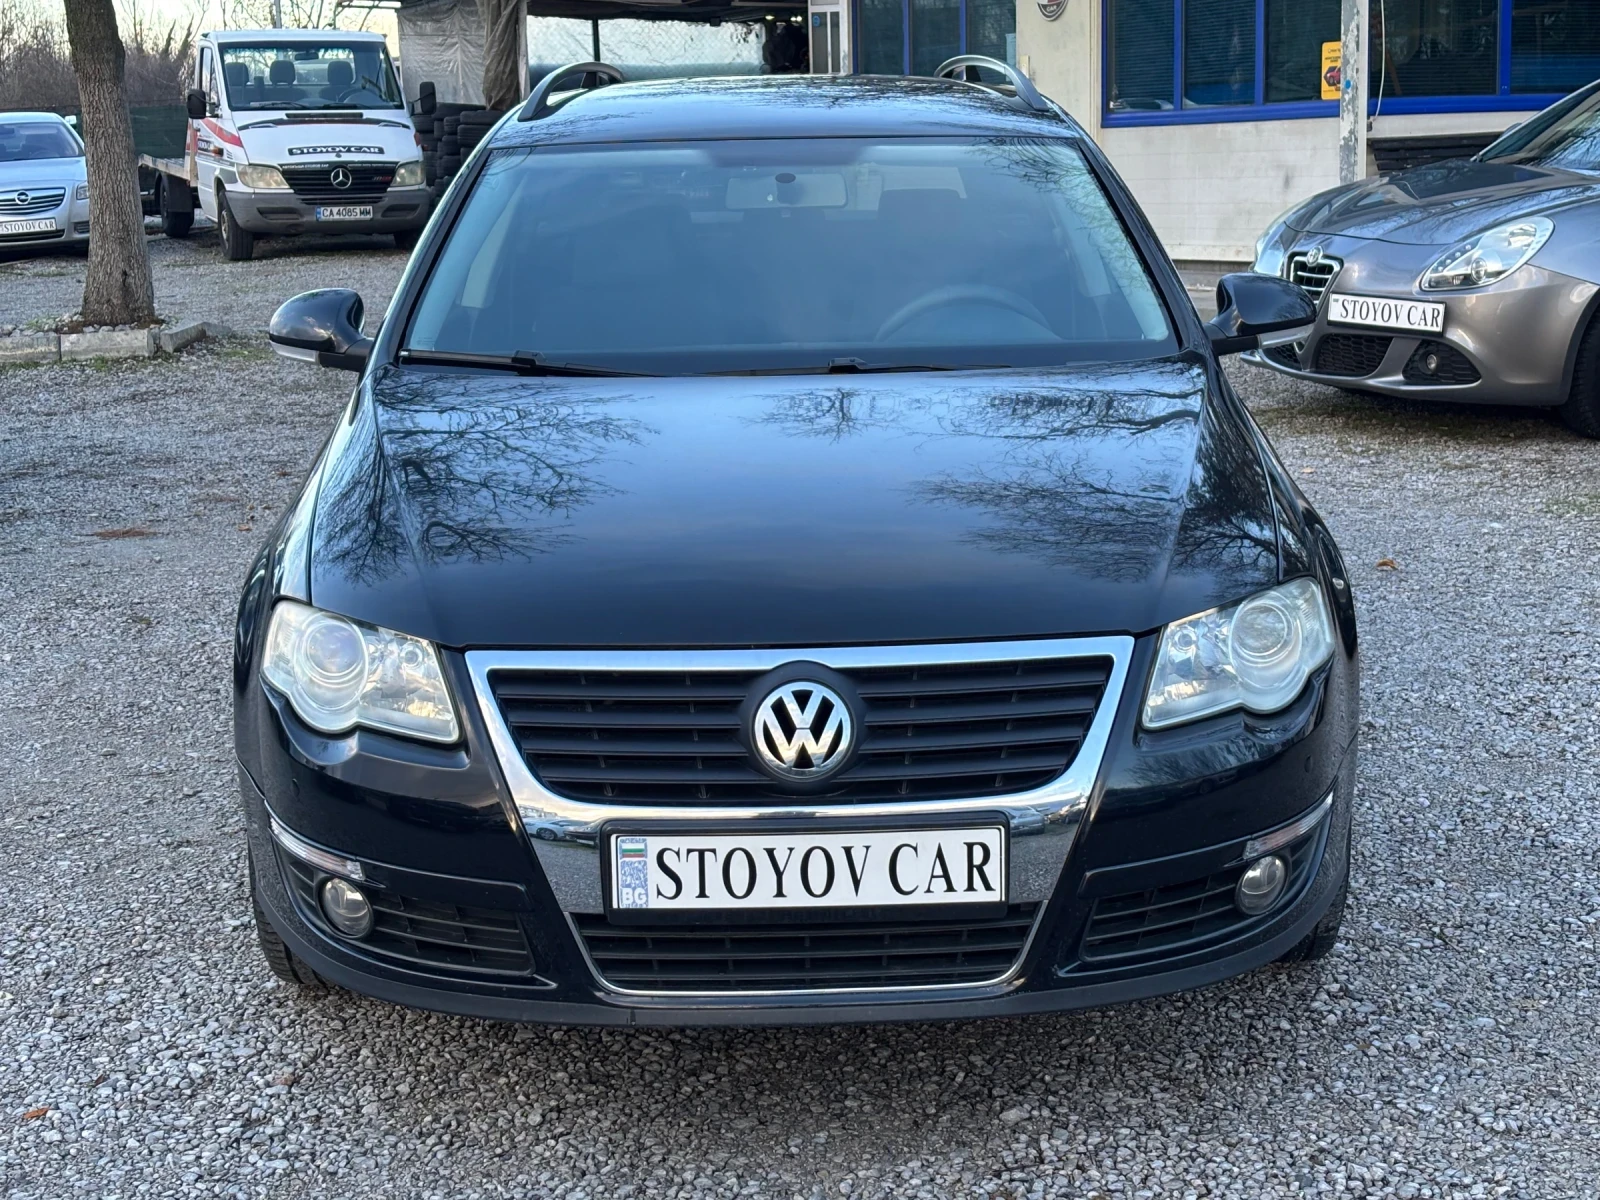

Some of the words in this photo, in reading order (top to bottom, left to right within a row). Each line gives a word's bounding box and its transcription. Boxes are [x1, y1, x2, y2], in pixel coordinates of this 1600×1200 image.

[322, 208, 334, 217] CA
[336, 208, 358, 217] 4085
[360, 208, 371, 217] MM
[4, 222, 36, 232] STOYOV
[38, 220, 54, 230] CAR
[1340, 298, 1403, 324] STOYOV
[1407, 305, 1440, 328] CAR
[656, 844, 872, 900] STOYOV
[888, 841, 996, 896] CAR
[622, 887, 647, 904] BG
